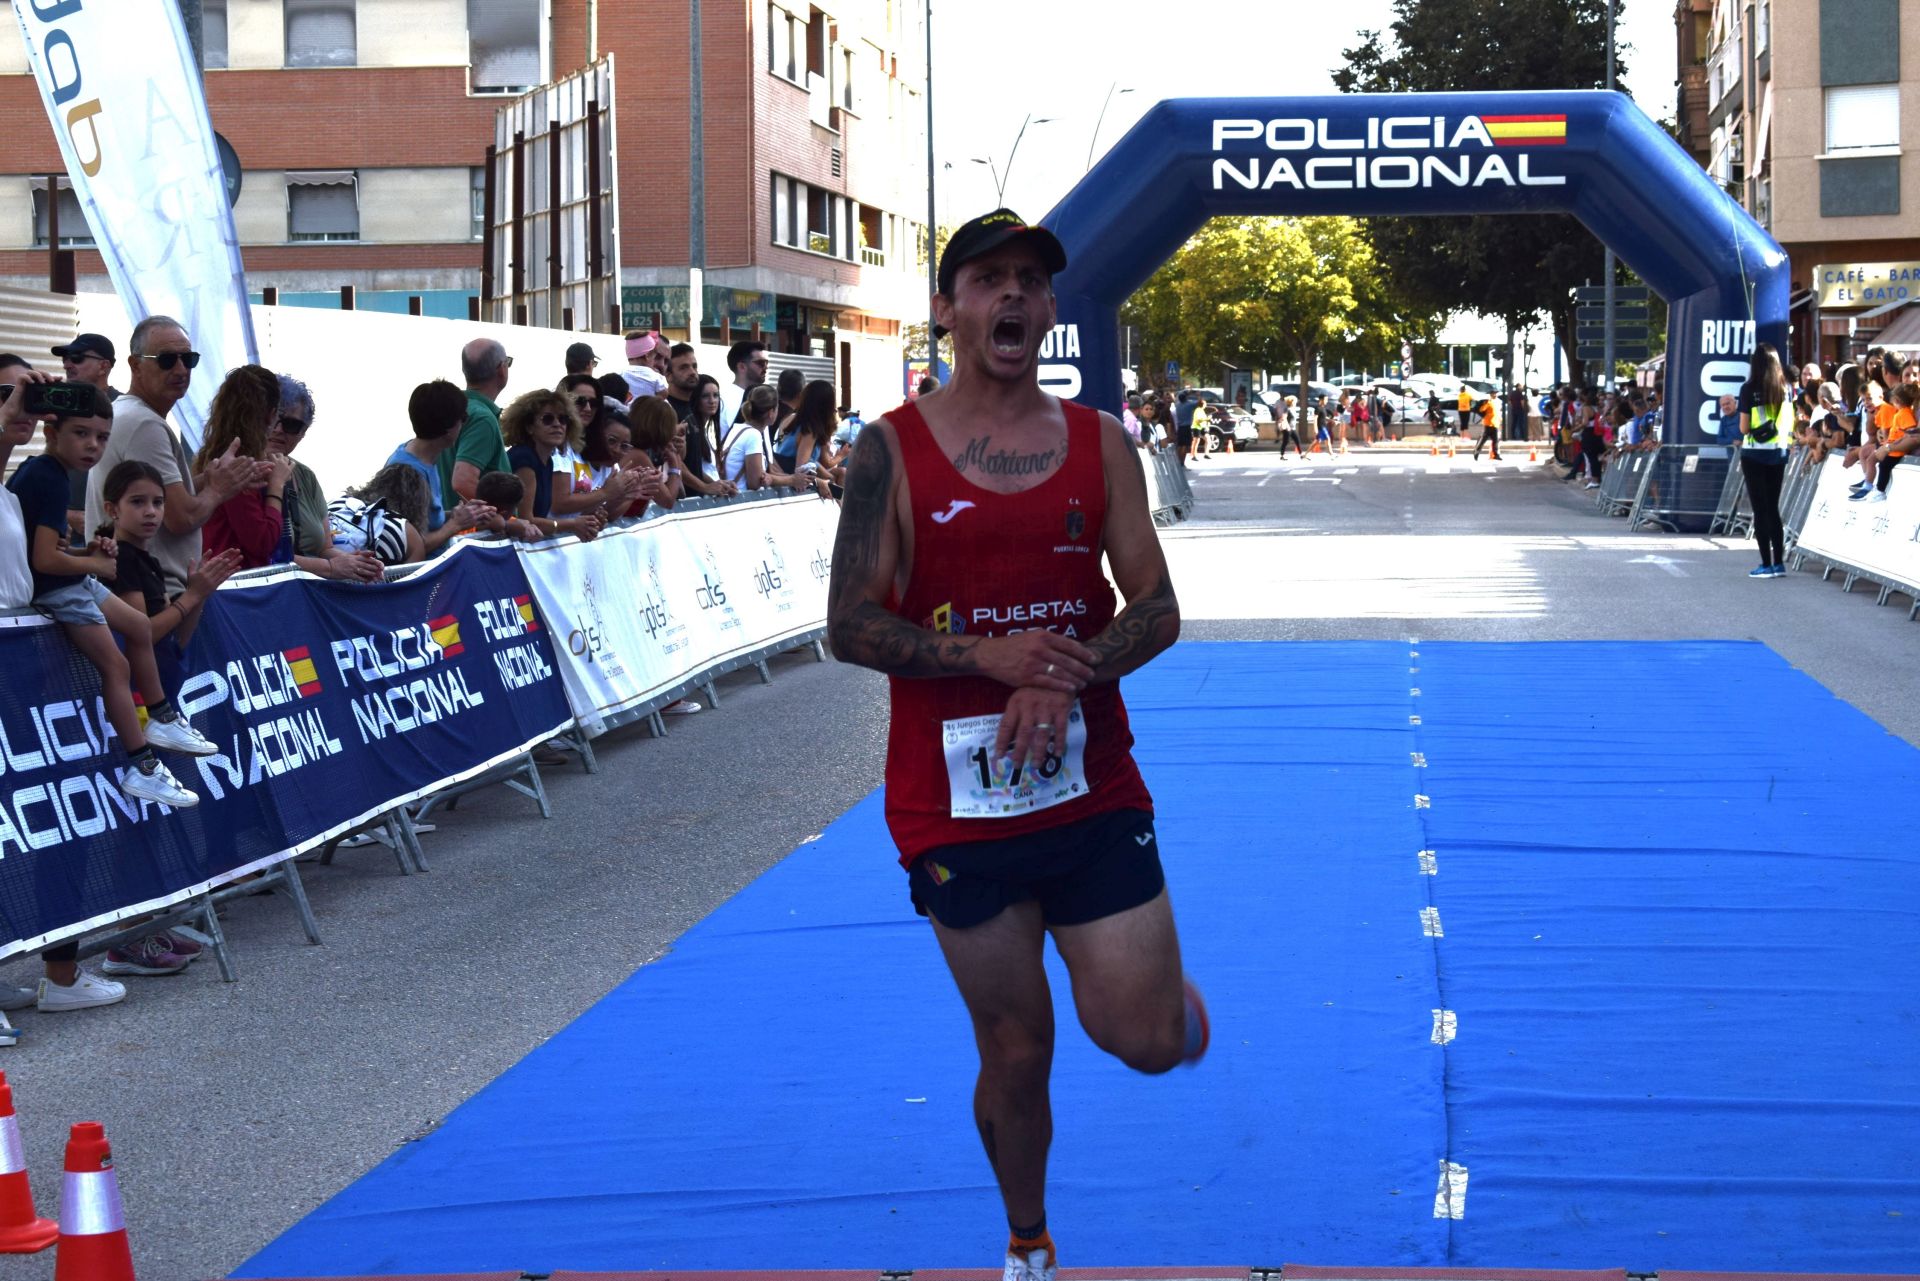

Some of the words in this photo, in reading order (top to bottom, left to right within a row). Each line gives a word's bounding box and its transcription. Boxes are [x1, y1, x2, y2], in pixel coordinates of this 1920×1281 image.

[1212, 154, 1566, 190] NACIONAL
[1824, 267, 1865, 284] CAFÉ
[1889, 268, 1920, 281] BAR
[1838, 288, 1855, 300] EL
[1863, 286, 1908, 300] GATO
[621, 302, 675, 315] RRILLO,
[1038, 324, 1081, 359] UTA
[1701, 320, 1757, 355] RUTA
[954, 436, 1056, 475] Mariano
[973, 599, 1087, 624] PUERTAS
[350, 666, 485, 744] NACIONAL
[194, 707, 344, 801] NACIONAL
